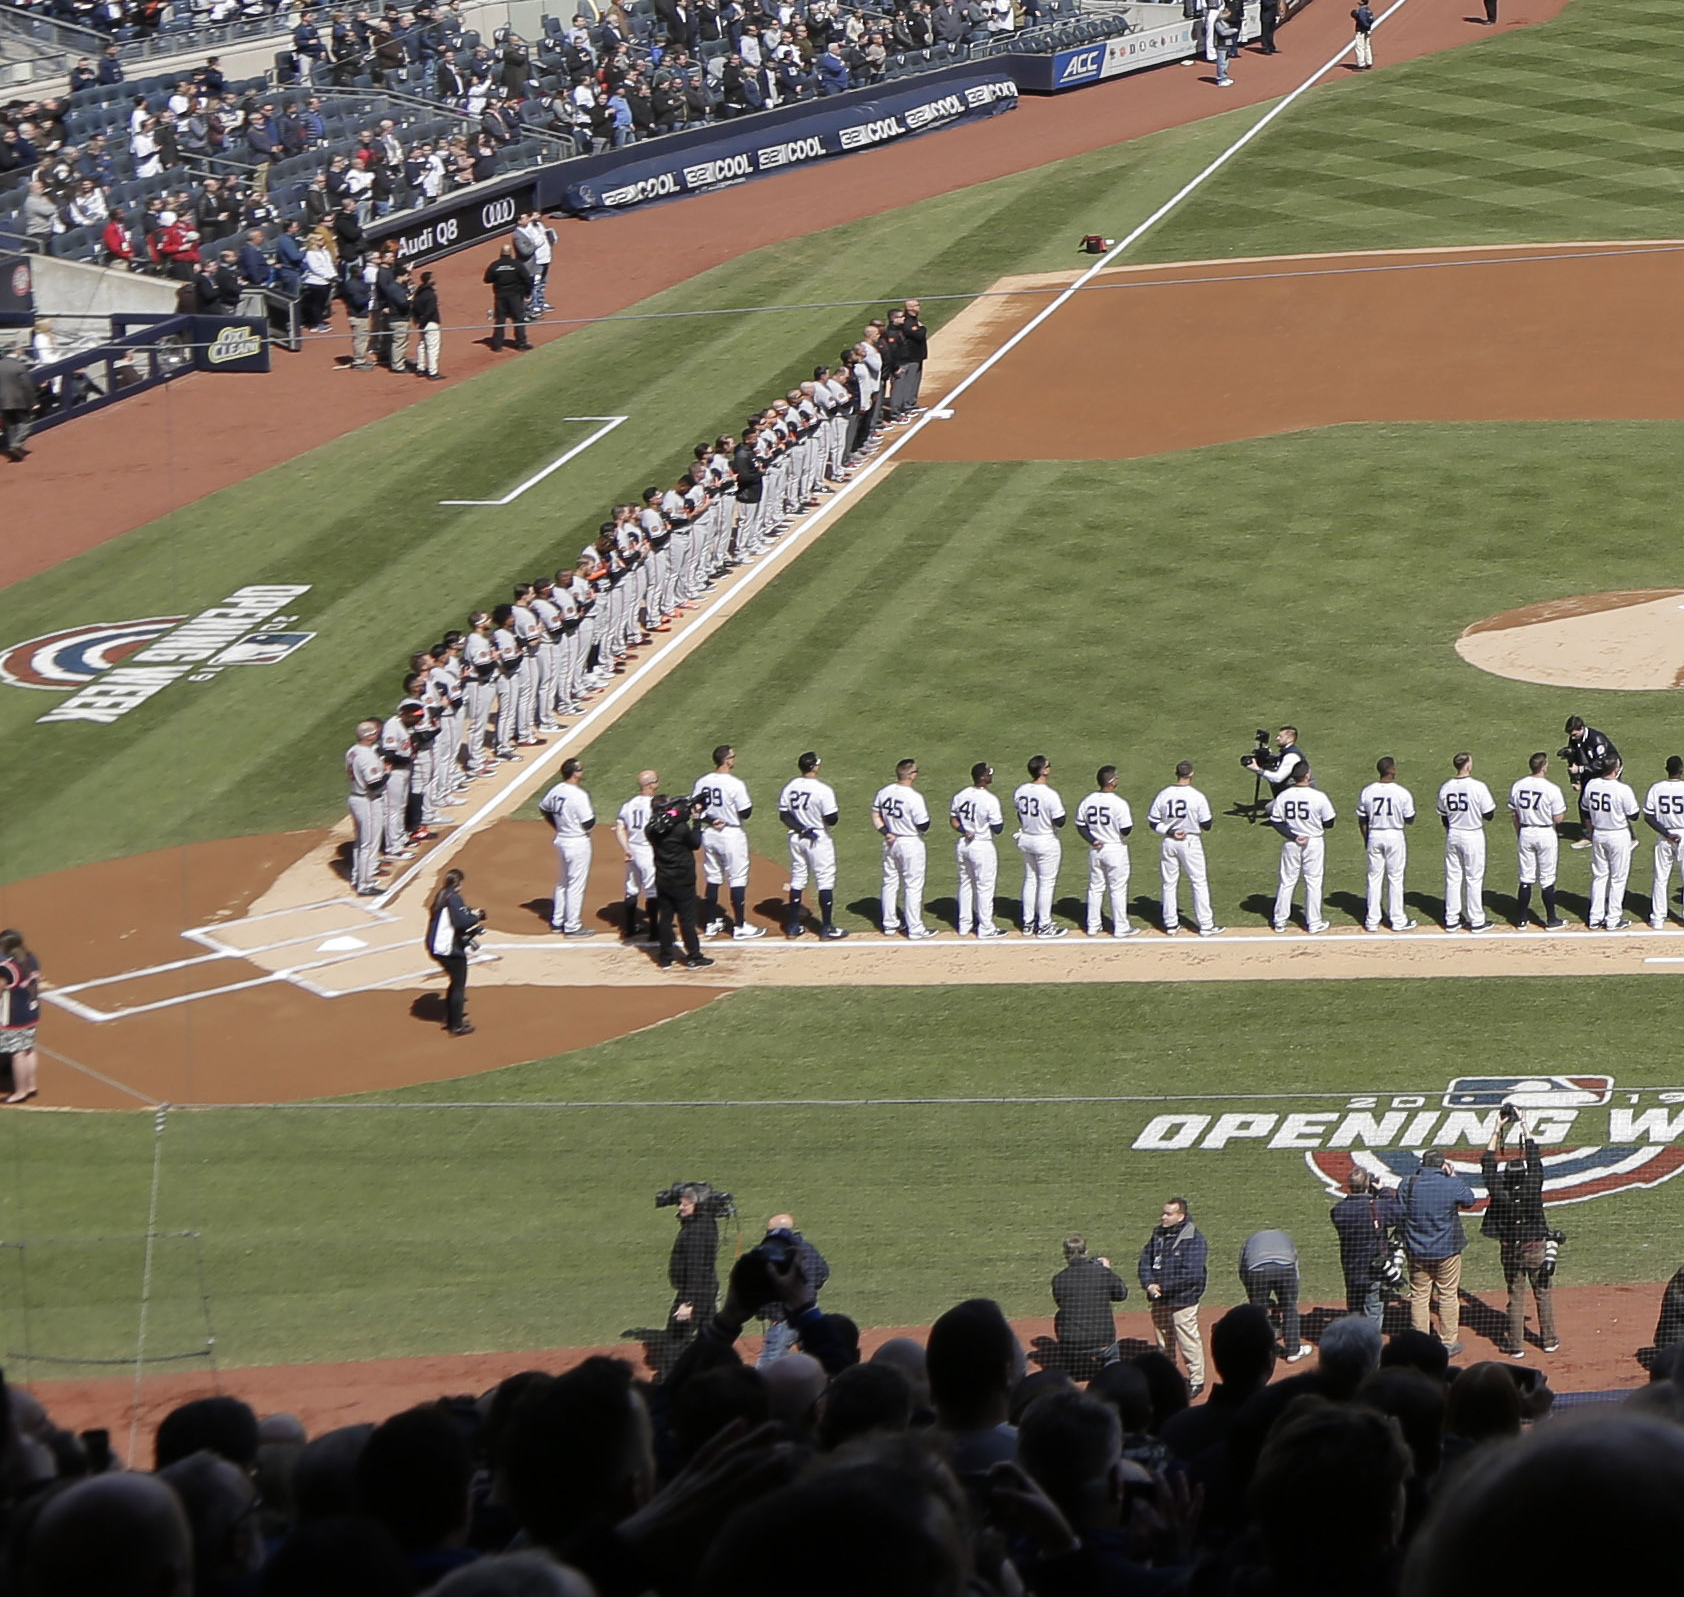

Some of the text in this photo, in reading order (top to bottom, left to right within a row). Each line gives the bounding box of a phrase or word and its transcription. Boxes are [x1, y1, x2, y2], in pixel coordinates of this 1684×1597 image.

[1063, 51, 1100, 78] ACC
[932, 95, 966, 118] COOL
[867, 116, 906, 142] COOL
[788, 136, 827, 162] COOL
[715, 153, 754, 181] COOL
[637, 171, 681, 200] COOL
[398, 218, 459, 258] Audi Q8
[222, 328, 249, 342] OXI
[788, 790, 812, 811] 27
[881, 796, 905, 819] 45
[1018, 796, 1040, 817] 33
[1166, 799, 1188, 819] 12
[1284, 801, 1310, 820] 85
[1372, 797, 1393, 817] 71
[1445, 793, 1469, 812] 65
[1518, 791, 1543, 810] 57
[1589, 792, 1612, 812] 56
[1658, 795, 1684, 815] 55
[958, 800, 976, 823] 41
[1087, 805, 1111, 826] 25
[1130, 1108, 1578, 1151] OPENING
